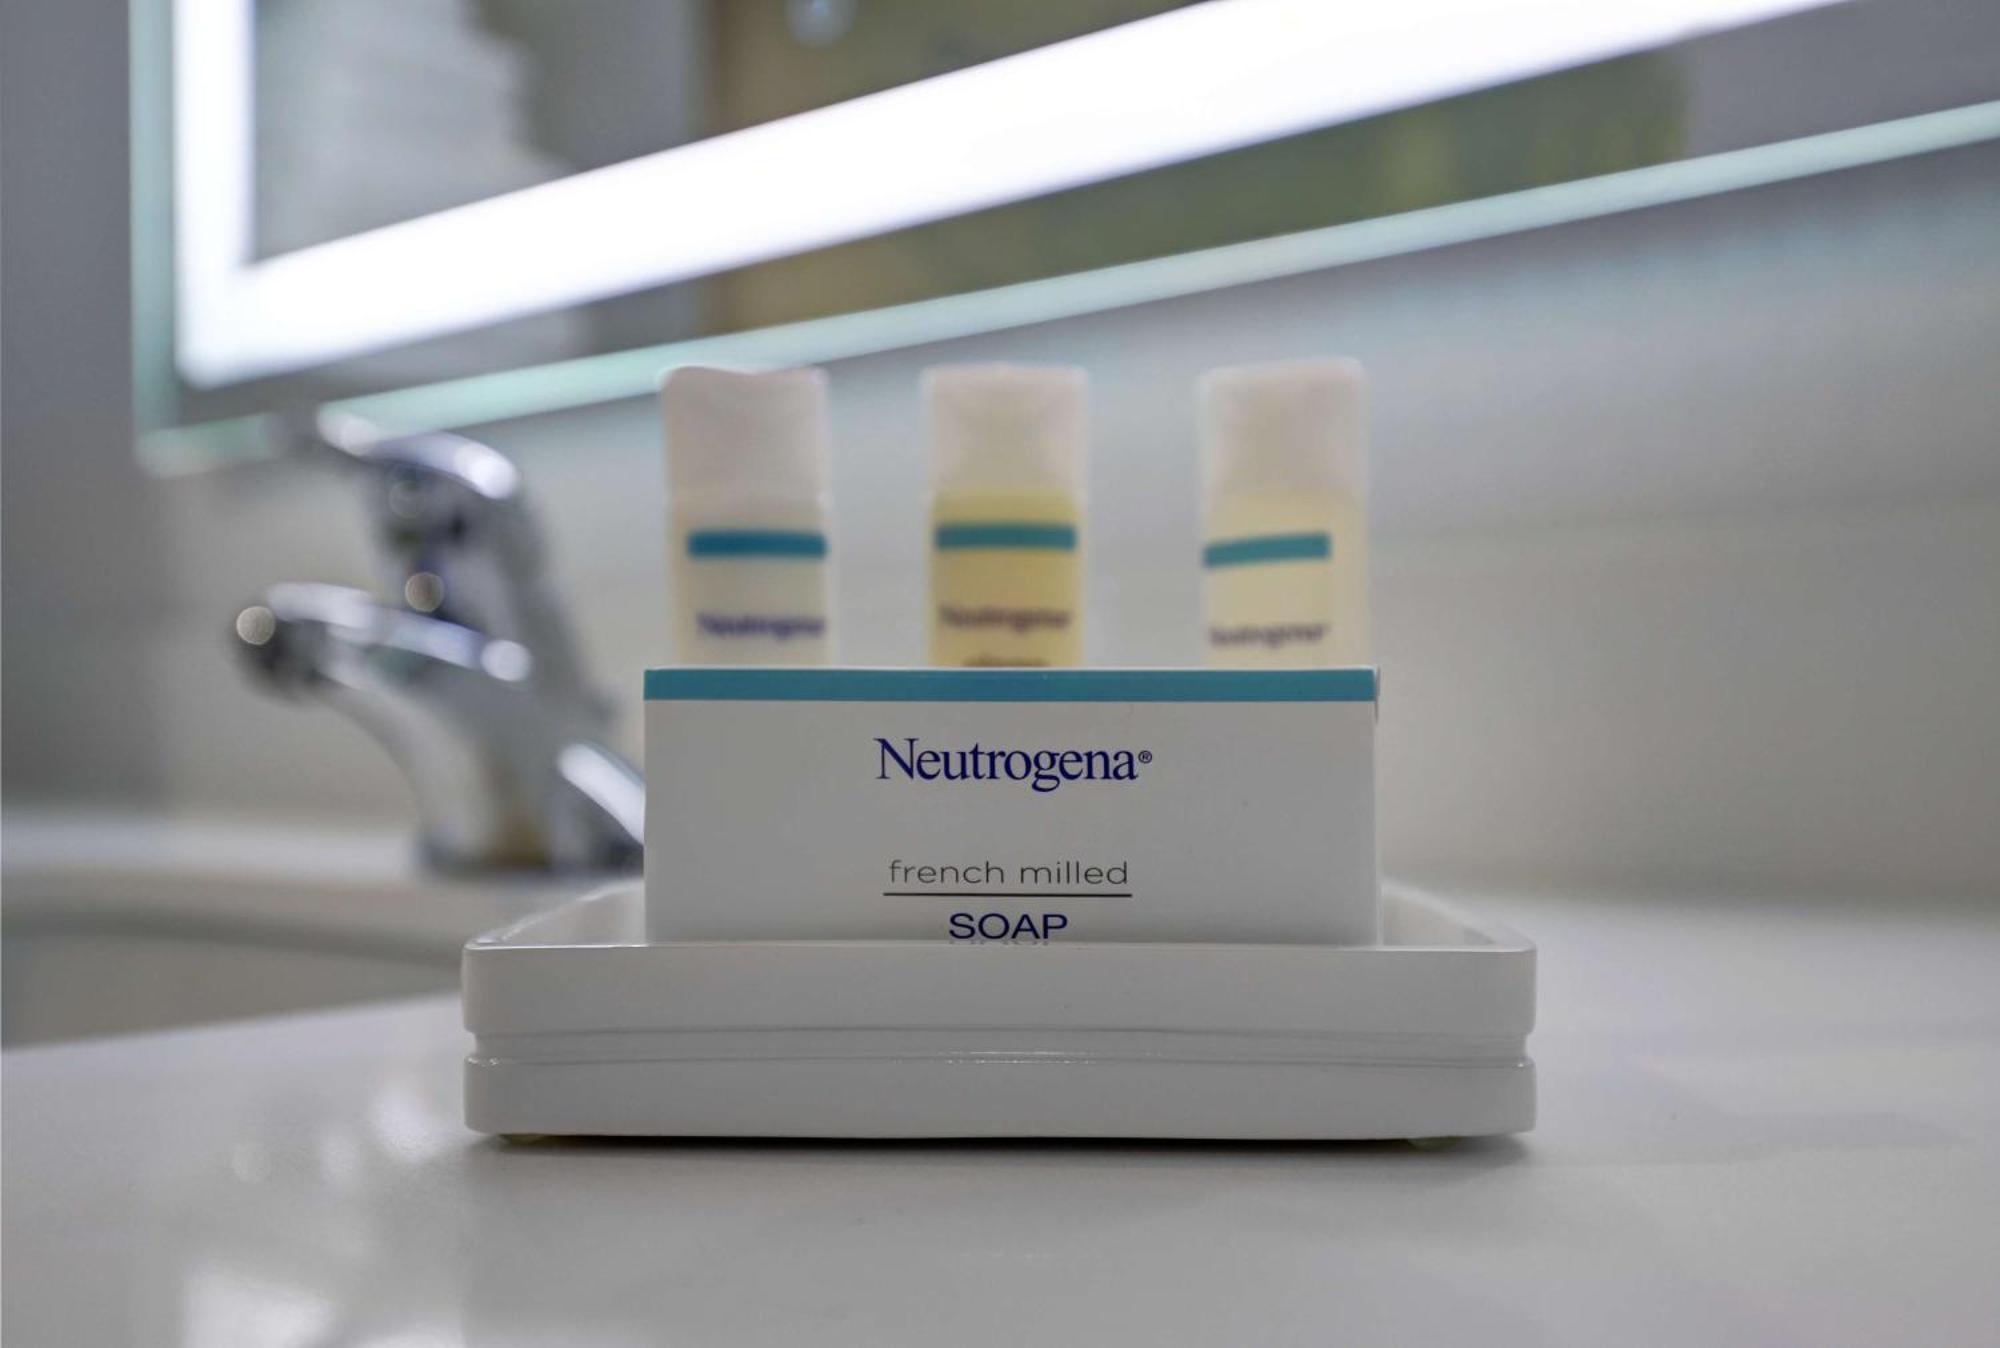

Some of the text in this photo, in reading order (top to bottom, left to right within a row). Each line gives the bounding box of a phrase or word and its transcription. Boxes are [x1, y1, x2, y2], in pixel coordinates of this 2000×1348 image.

[889, 859, 1128, 885] french milled
[948, 912, 1068, 940] SOAP
